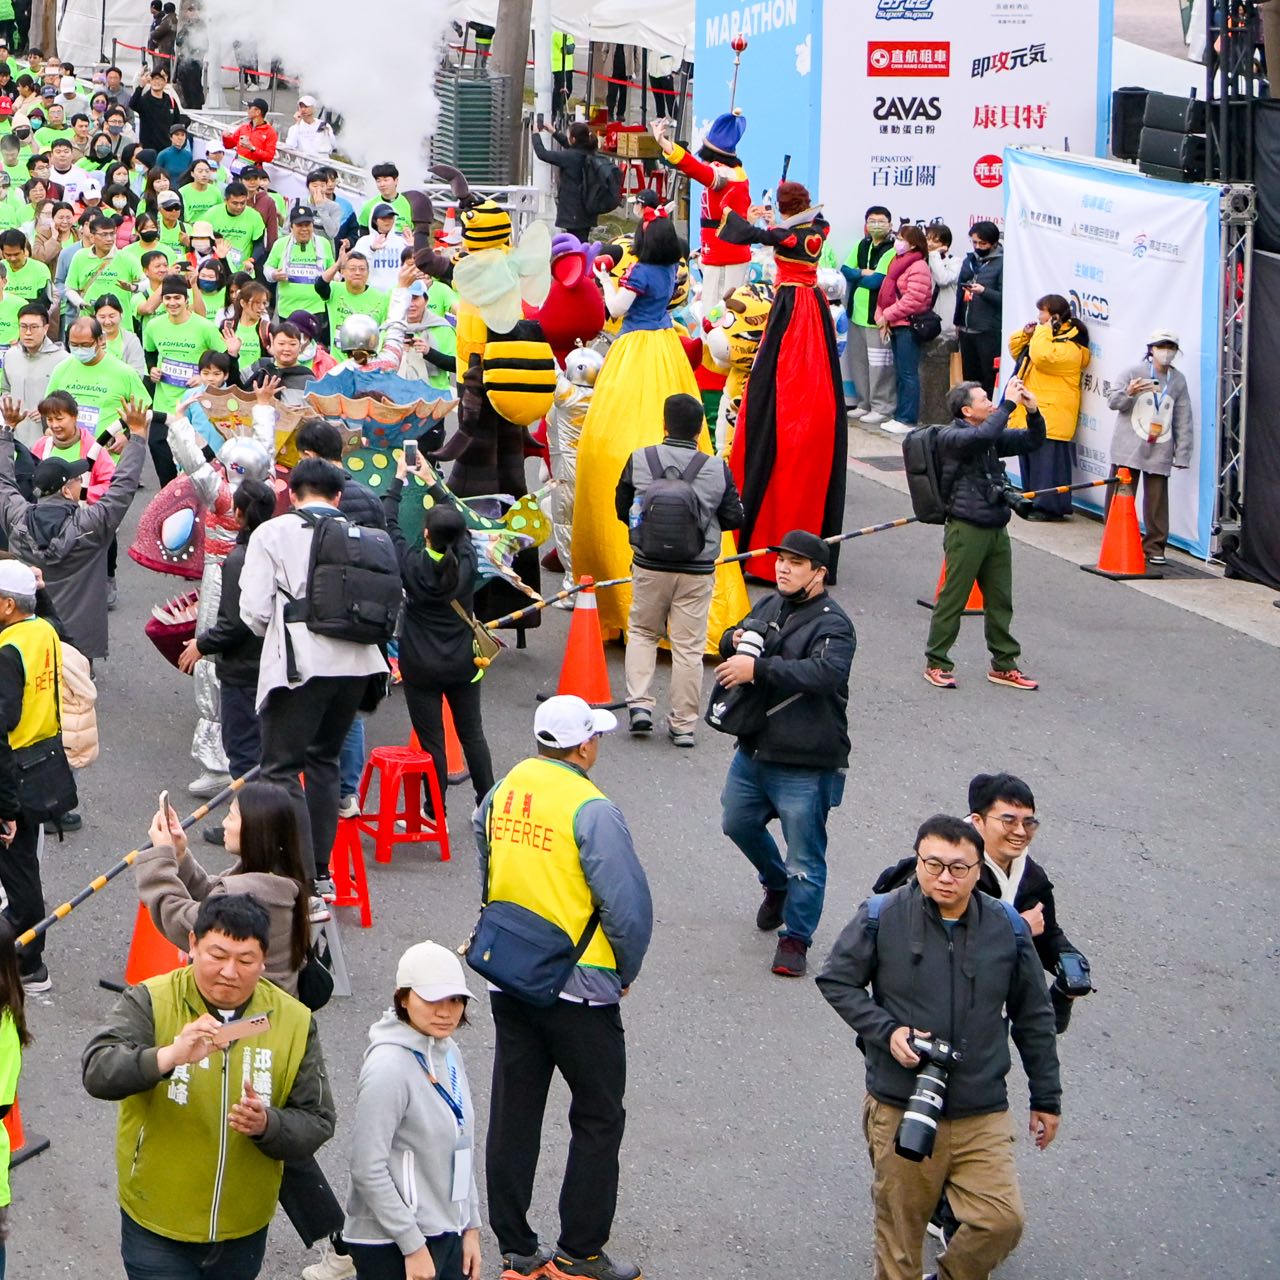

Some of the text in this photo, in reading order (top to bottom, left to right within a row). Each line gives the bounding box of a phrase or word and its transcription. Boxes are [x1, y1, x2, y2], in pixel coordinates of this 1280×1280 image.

[873, 96, 942, 120] SAVAS
[973, 105, 1048, 129] 康貝特
[879, 124, 935, 134] 運動蛋白粉
[873, 165, 936, 187] 百通關
[490, 817, 554, 852] REFEREE
